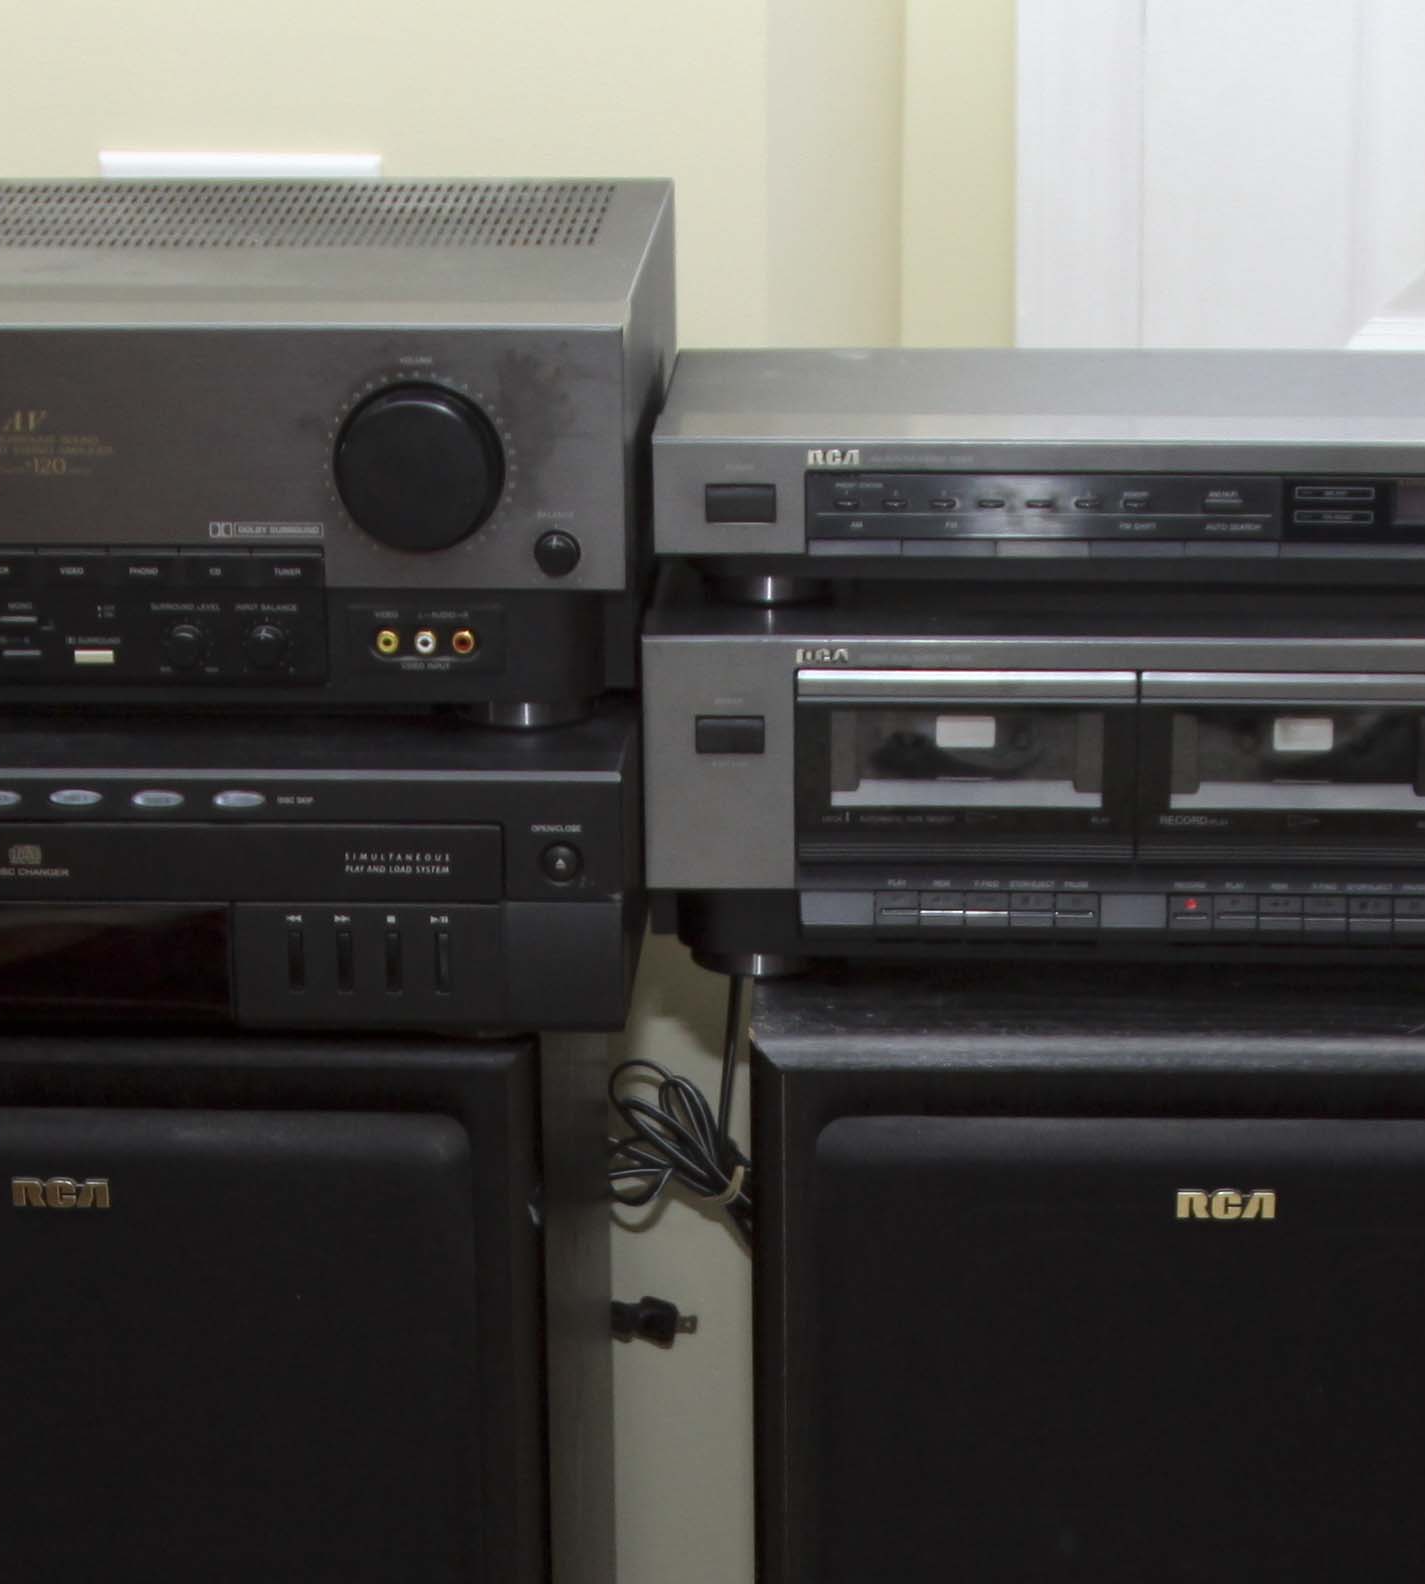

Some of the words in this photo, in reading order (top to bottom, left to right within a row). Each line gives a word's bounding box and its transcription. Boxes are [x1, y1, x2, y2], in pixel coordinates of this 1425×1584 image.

[806, 448, 860, 466] RCA
[33, 456, 66, 474] 120
[238, 525, 267, 536] DOLBY
[270, 525, 319, 536] SURROUND
[1205, 522, 1227, 532] AUTO
[59, 566, 85, 576] VIDEO
[129, 566, 159, 577] PHONO
[209, 566, 223, 577] CD
[273, 566, 301, 577] TUNER
[7, 601, 33, 611] MONO
[151, 602, 194, 613] SURROUND
[196, 602, 221, 612] LEVEL
[261, 603, 298, 613] BALANCE
[401, 662, 425, 672] VIDEO
[427, 662, 450, 672] INPUT
[530, 823, 583, 834] OPEN/CLOSE
[344, 850, 452, 863] SIMULTANEOUS
[17, 867, 71, 878] CHANGER
[344, 864, 365, 875] PLAY
[366, 864, 386, 875] AND
[389, 864, 413, 875] LOAD
[416, 864, 451, 875] SYSTEM
[888, 878, 907, 888] PLAY
[11, 1177, 110, 1208] RCA
[1176, 1188, 1276, 1219] RCA
